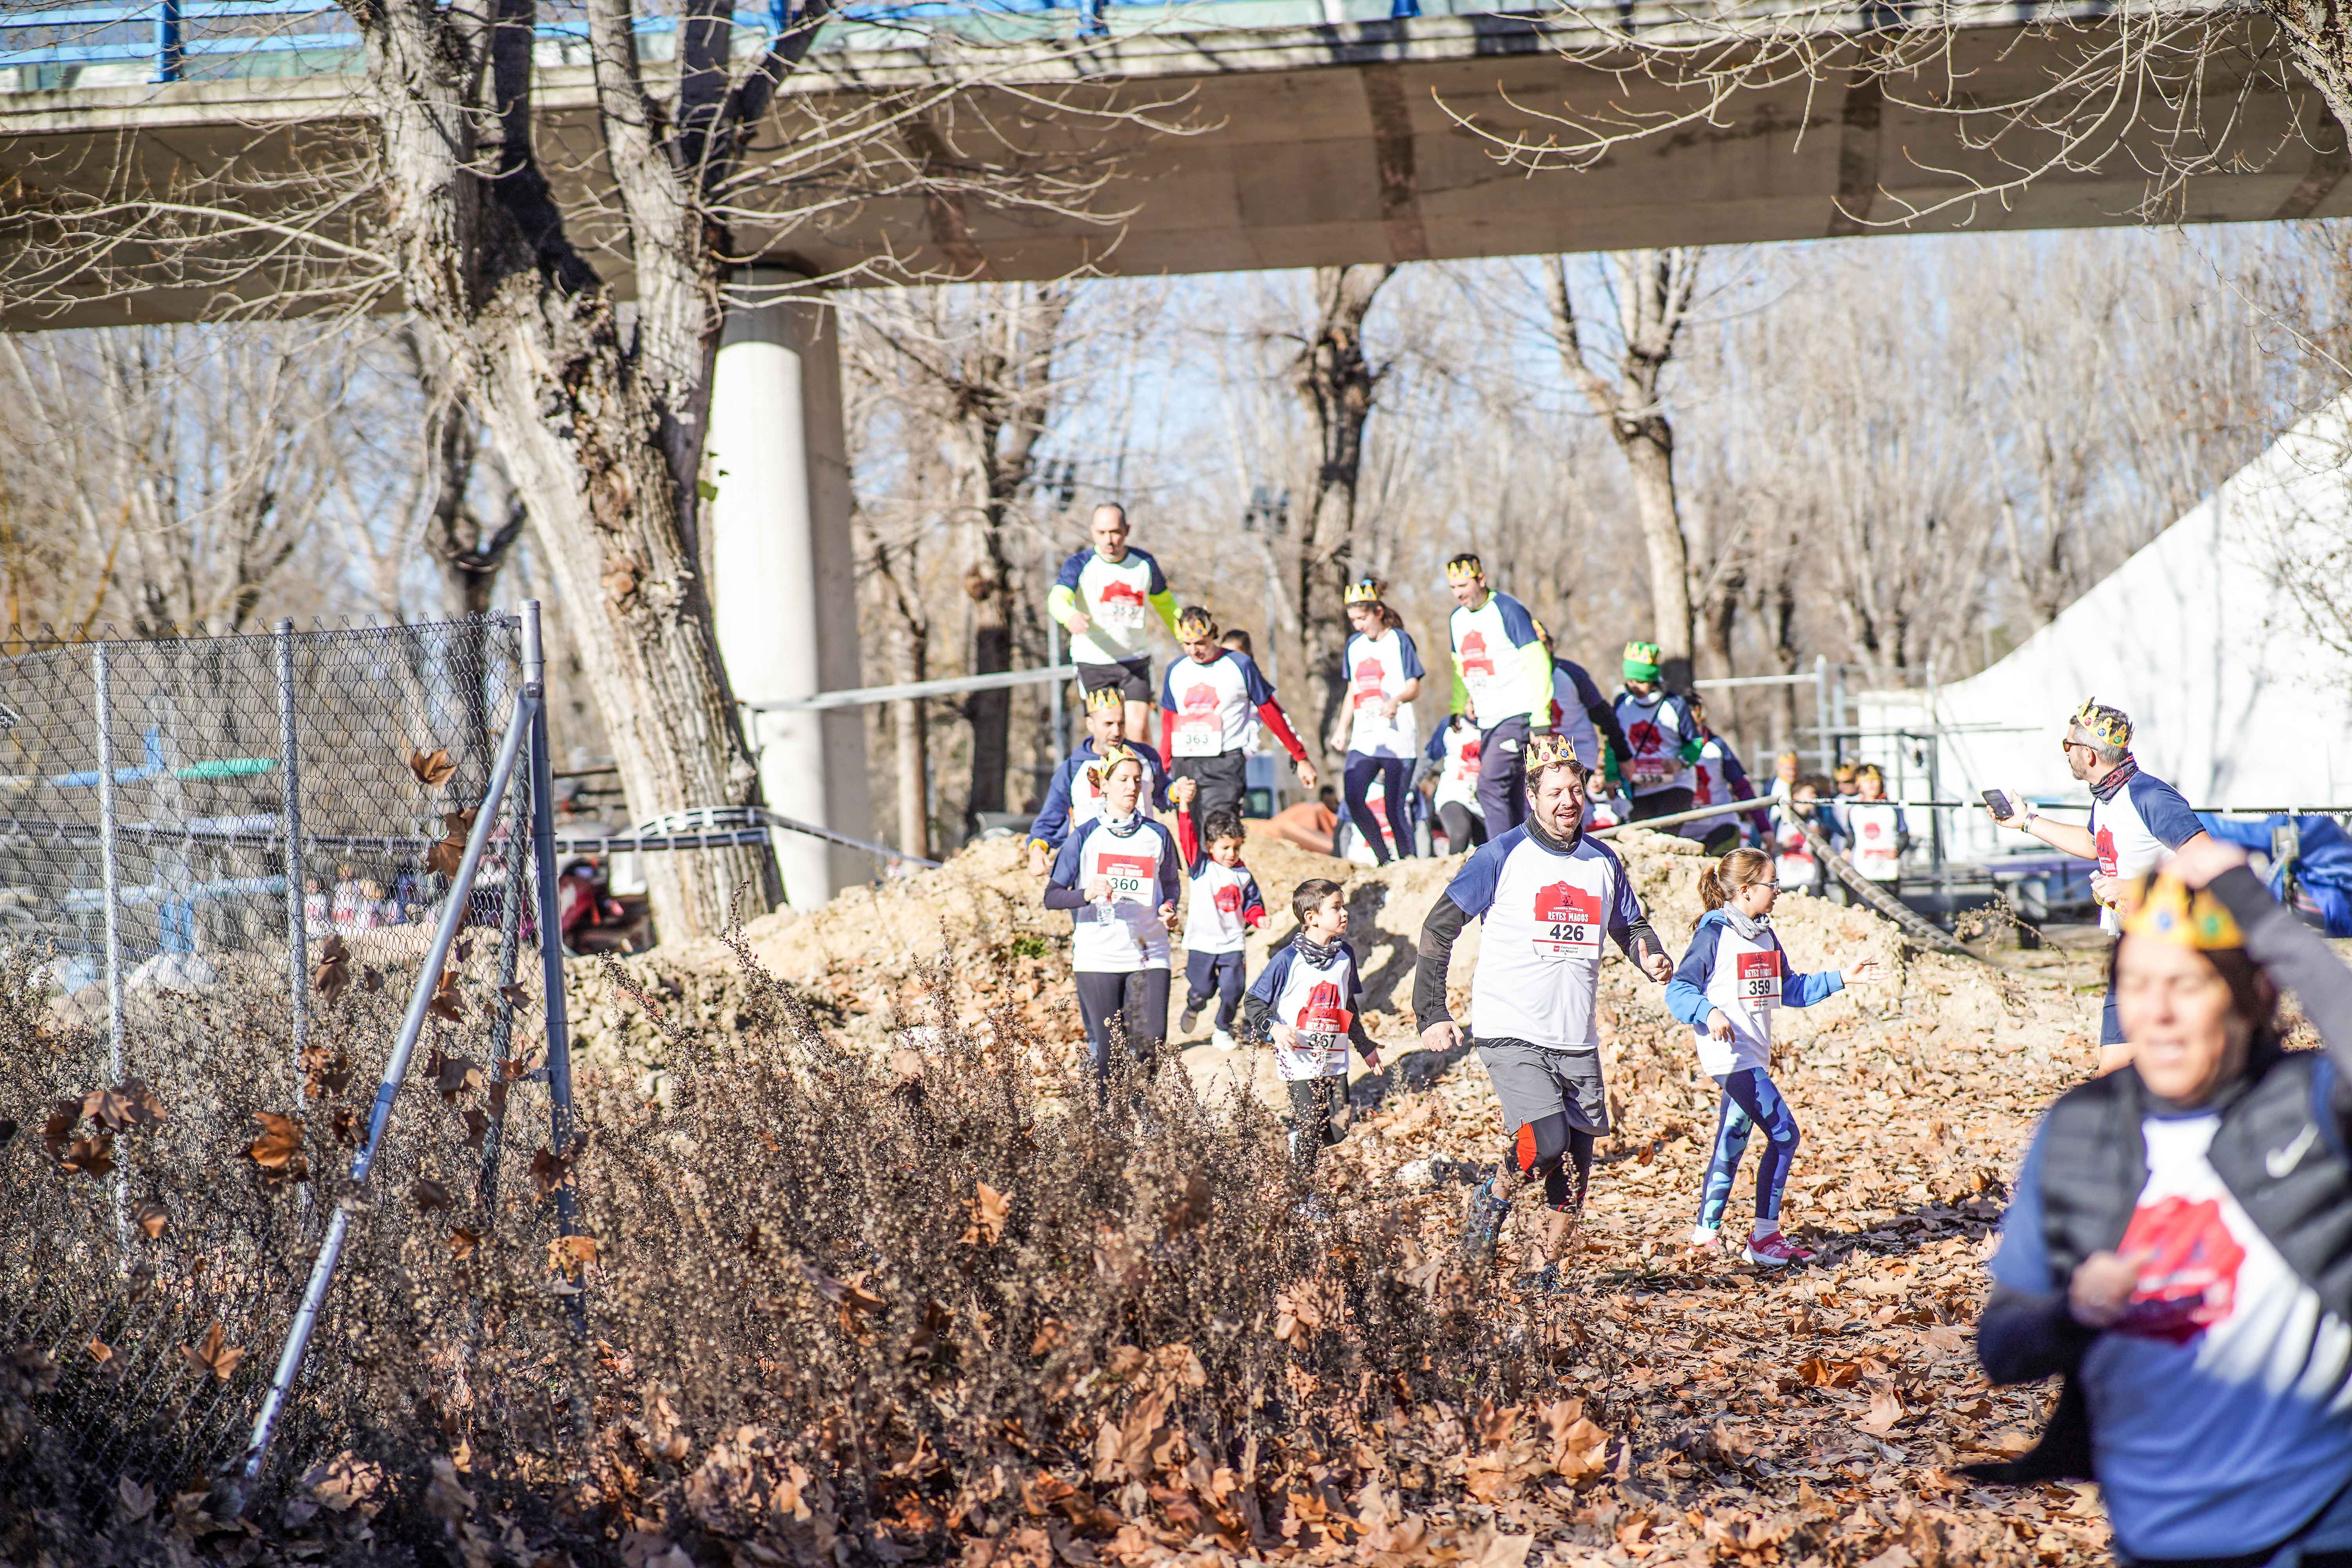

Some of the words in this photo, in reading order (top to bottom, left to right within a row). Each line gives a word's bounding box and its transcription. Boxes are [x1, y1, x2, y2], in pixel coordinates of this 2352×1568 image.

[1185, 734, 1209, 744] 363
[1111, 878, 1138, 891] 360
[1548, 911, 1567, 921] REYES
[1568, 913, 1589, 922] MAGOS
[1550, 924, 1584, 941] 426
[1744, 969, 1759, 978] REYES
[1749, 979, 1770, 995] 359
[1308, 1033, 1337, 1048] 367
